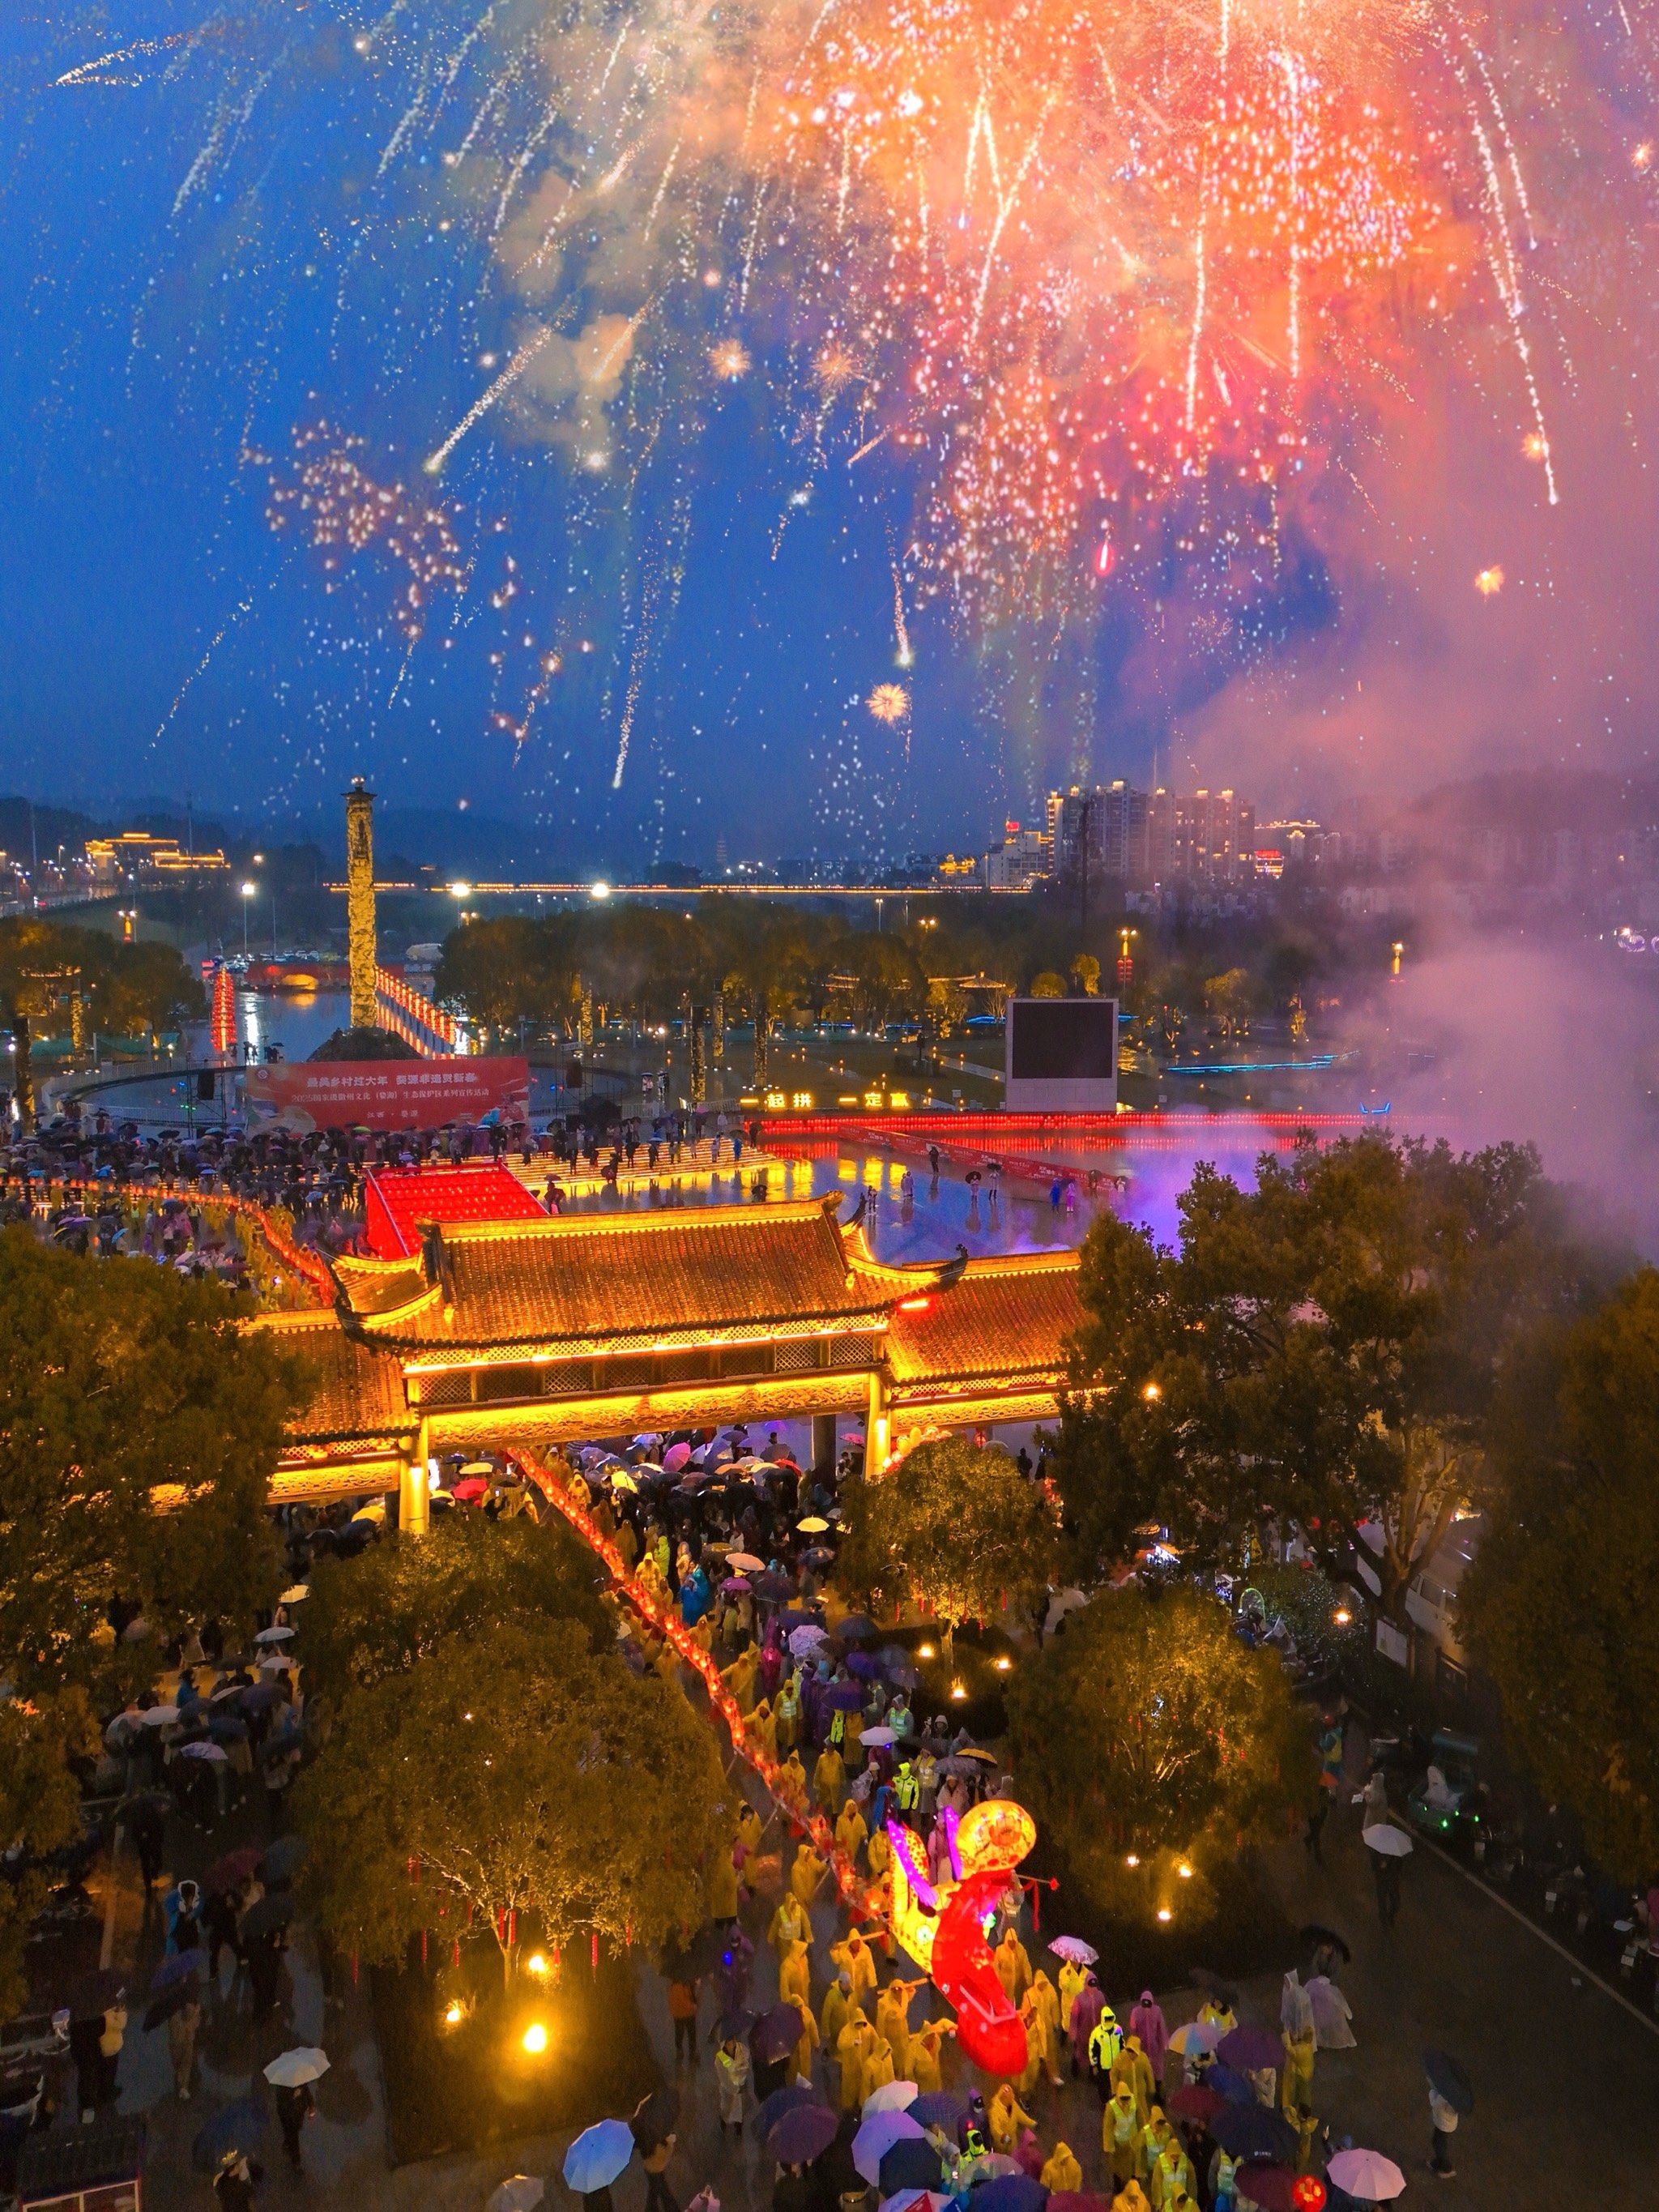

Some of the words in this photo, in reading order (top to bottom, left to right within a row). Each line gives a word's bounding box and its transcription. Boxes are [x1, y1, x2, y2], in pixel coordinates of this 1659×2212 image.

[740, 1093, 811, 1108] 一起拼
[839, 1093, 909, 1107] 一定赢
